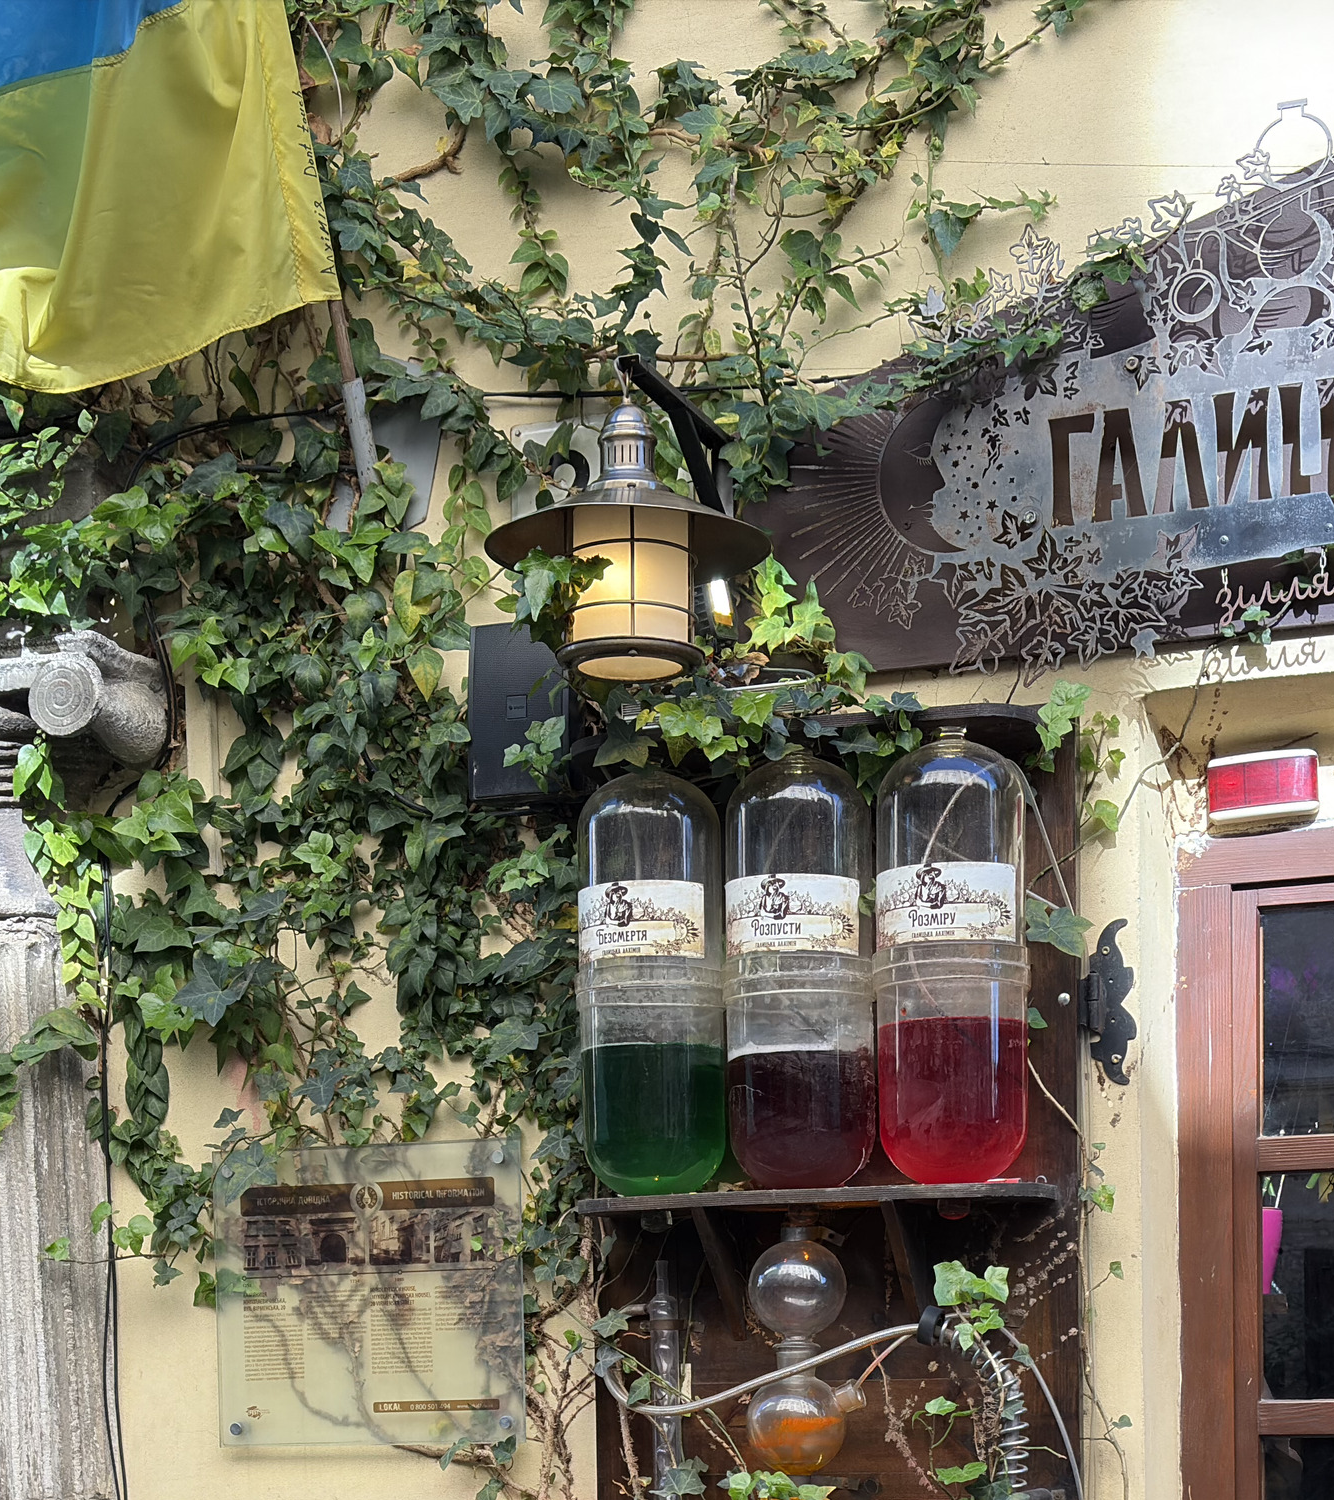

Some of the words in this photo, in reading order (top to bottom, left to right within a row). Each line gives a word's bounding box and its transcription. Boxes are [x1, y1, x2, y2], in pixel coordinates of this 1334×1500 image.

[908, 909, 956, 927] РОЗМІРУ
[751, 919, 801, 936] РОЗПУСТИ
[596, 928, 647, 945] БЕЗСМЕРТЯ
[392, 1190, 434, 1200] HISTORICAL
